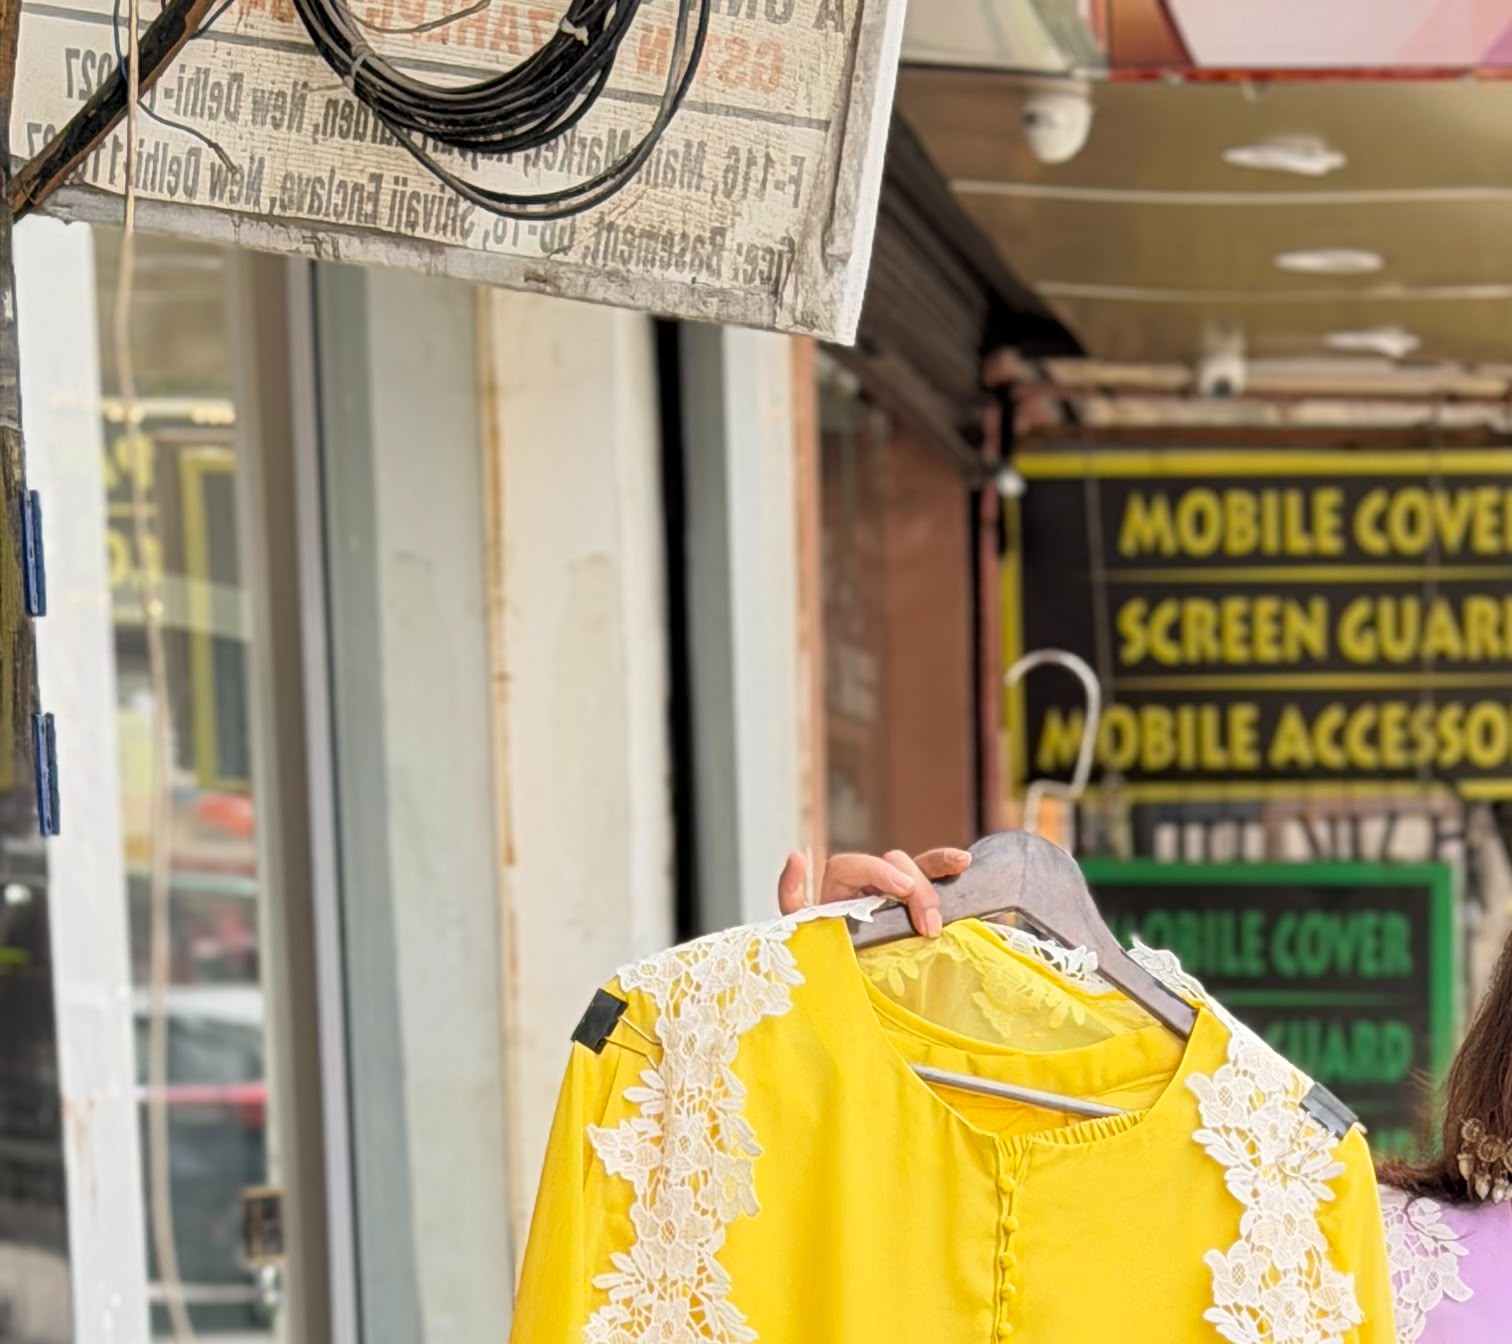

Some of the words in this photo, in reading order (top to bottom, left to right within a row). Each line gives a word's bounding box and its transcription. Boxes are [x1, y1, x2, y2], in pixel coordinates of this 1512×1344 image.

[1119, 487, 1346, 558] MOBILE
[1115, 595, 1330, 665] SCREEN
[1036, 704, 1259, 777] MOBILE
[1270, 908, 1413, 978] COVER
